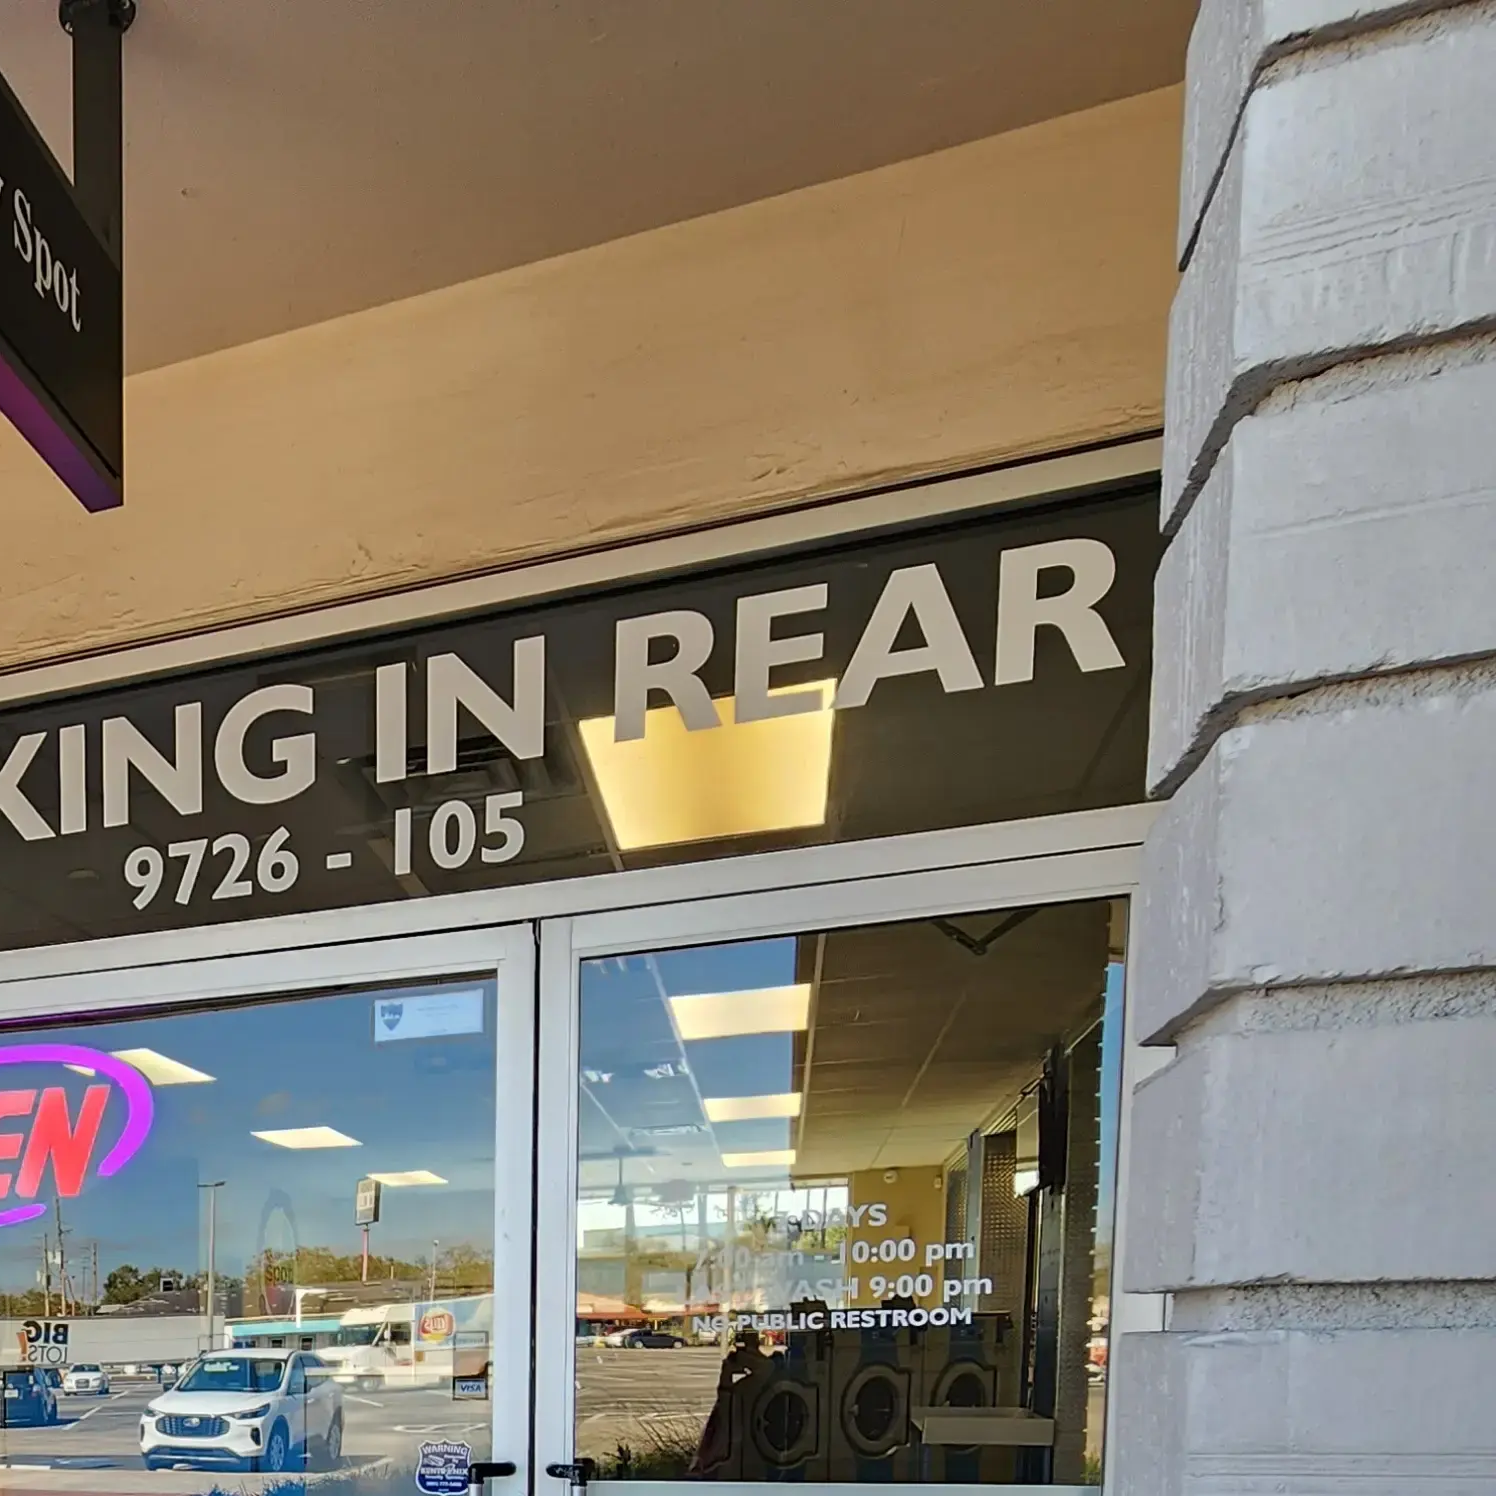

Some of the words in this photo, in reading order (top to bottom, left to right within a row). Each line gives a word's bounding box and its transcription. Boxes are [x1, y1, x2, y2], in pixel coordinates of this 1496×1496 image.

[14, 188, 82, 333] Spot
[376, 635, 545, 783] IN
[613, 538, 1126, 743] REAR
[124, 826, 300, 911] 9726
[326, 852, 352, 870] -
[394, 791, 525, 876] 105
[801, 1204, 888, 1232] DAYS
[839, 1239, 916, 1264] 10:00
[925, 1242, 975, 1267] pm
[869, 1274, 933, 1298] 9:00
[943, 1278, 993, 1303] pm
[737, 1311, 824, 1331] PUBLIC
[831, 1307, 972, 1329] RESTROOM
[460, 1384, 481, 1392] VISA
[422, 1444, 468, 1455] WARNING
